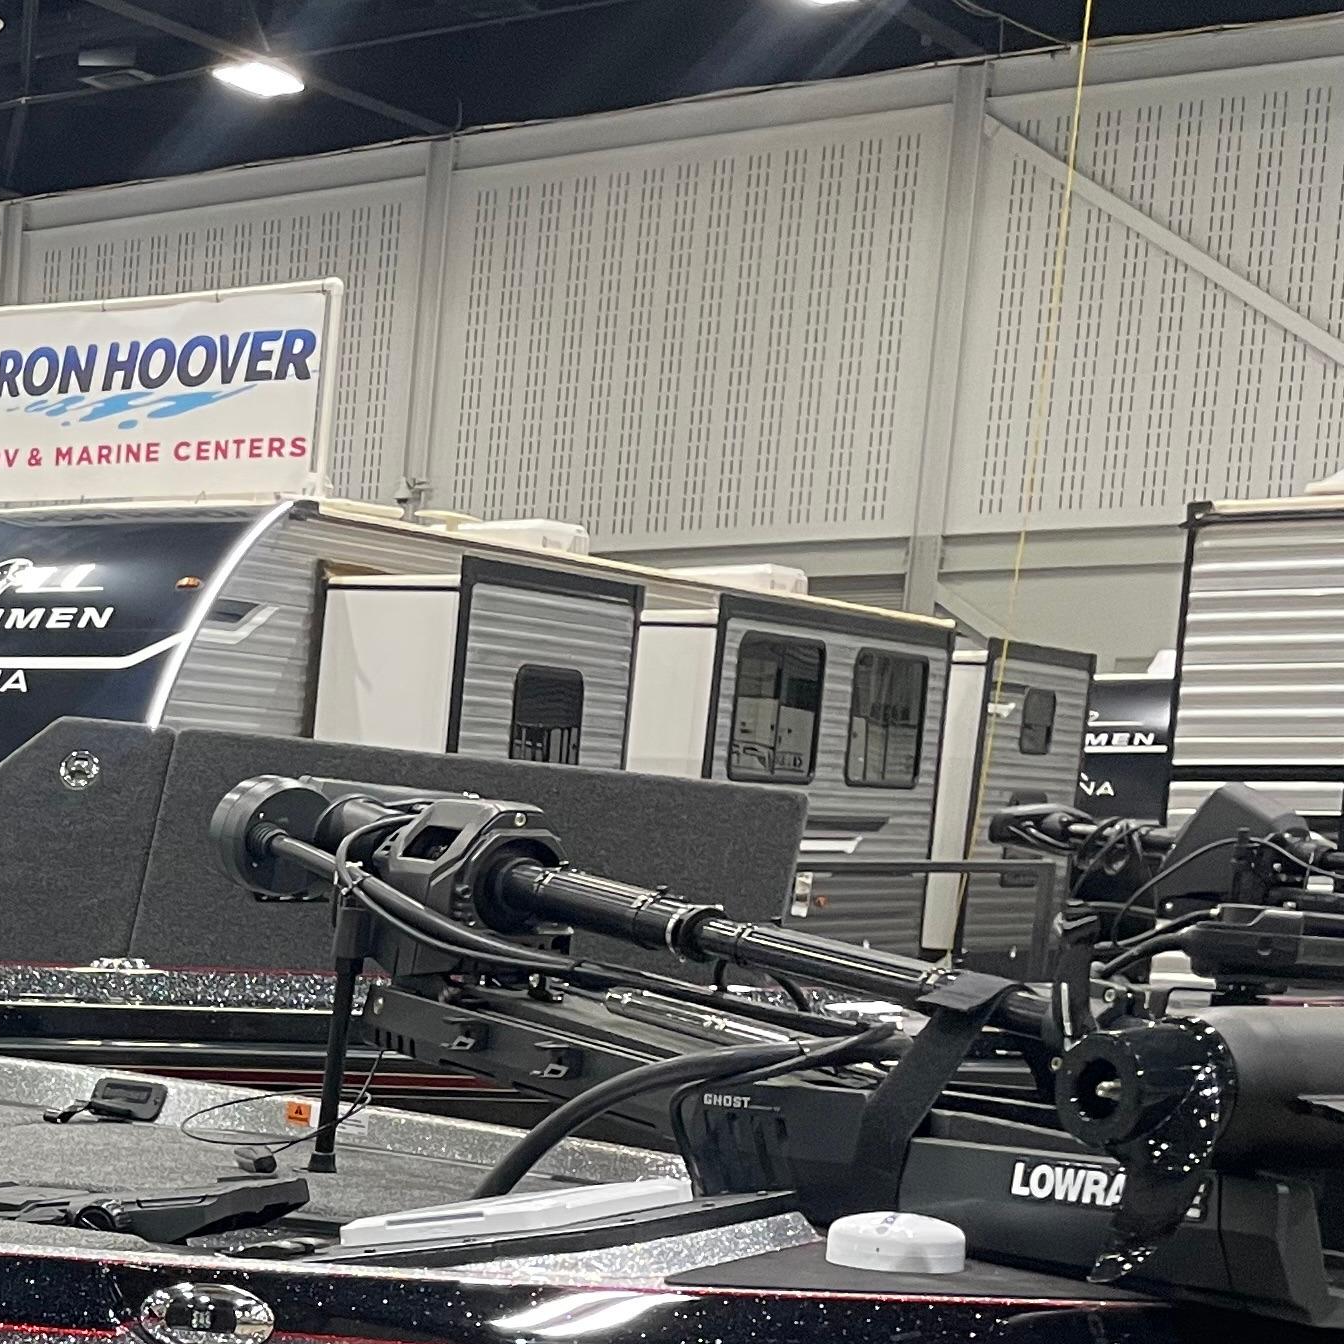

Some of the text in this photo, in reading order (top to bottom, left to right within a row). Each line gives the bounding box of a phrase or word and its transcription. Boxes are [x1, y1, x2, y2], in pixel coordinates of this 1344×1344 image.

[101, 329, 317, 392] HOOVER
[27, 448, 43, 467] &
[55, 442, 160, 466] MARINE
[173, 437, 307, 461] CENTERS
[703, 1093, 751, 1109] GHOST
